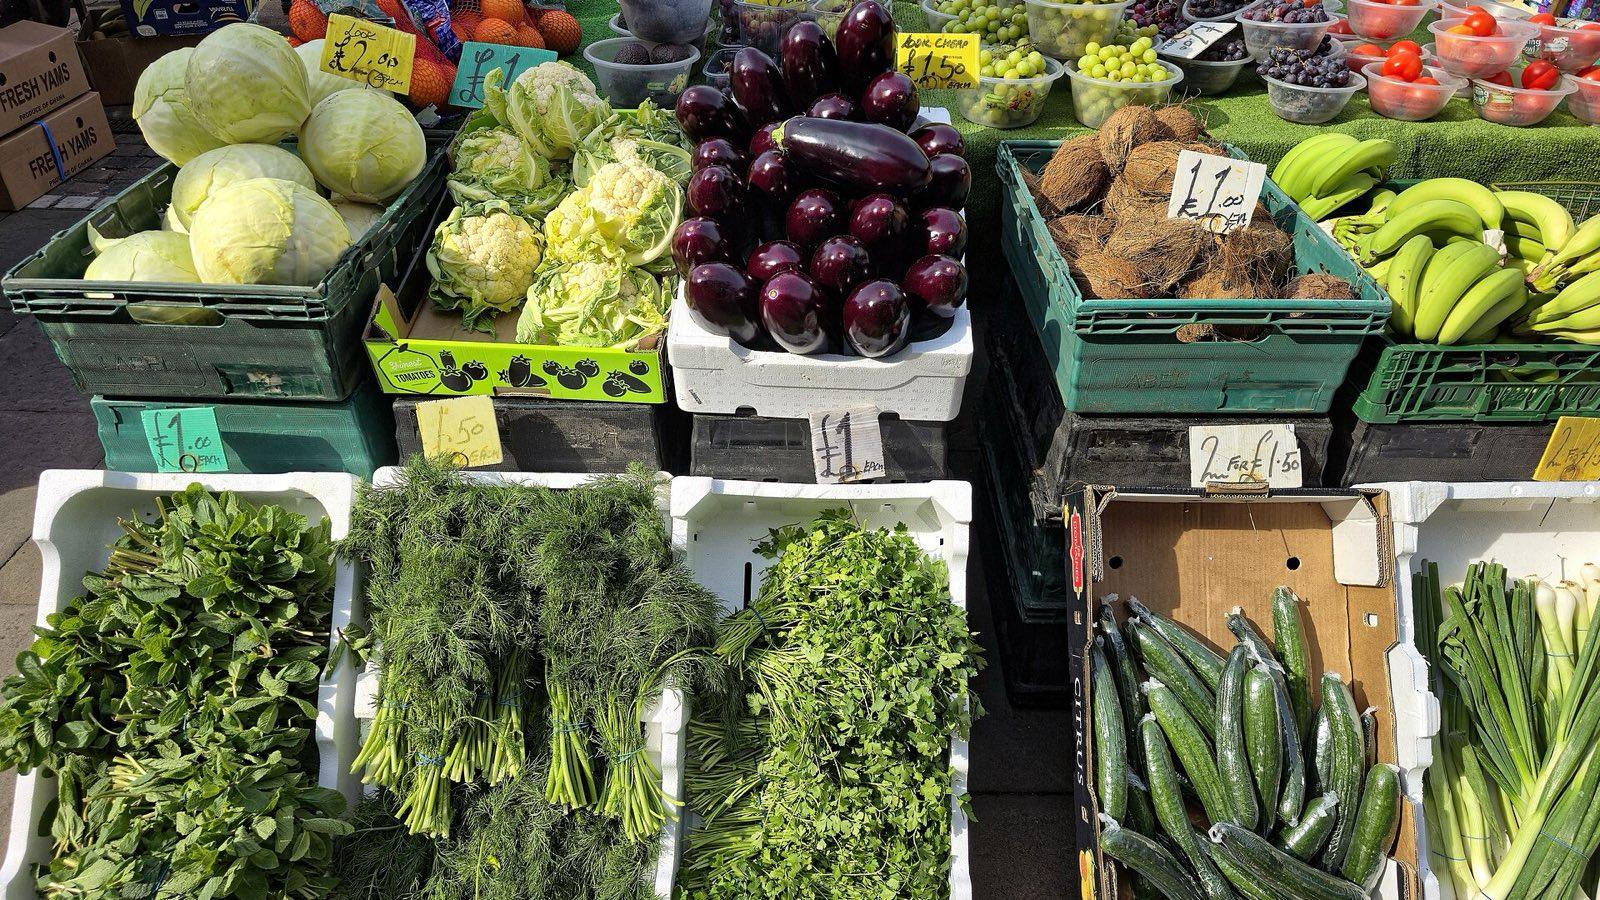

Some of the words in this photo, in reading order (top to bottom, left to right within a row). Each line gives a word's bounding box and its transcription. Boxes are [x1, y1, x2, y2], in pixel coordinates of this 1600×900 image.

[0, 78, 41, 113] FRESH
[39, 62, 70, 93] YAMS
[28, 143, 69, 180] FREH
[67, 126, 98, 156] YAMS
[394, 370, 436, 383] TOMATOES
[152, 410, 212, 469] £1.00
[815, 411, 852, 479] £1
[1074, 676, 1085, 787] CITRUS
